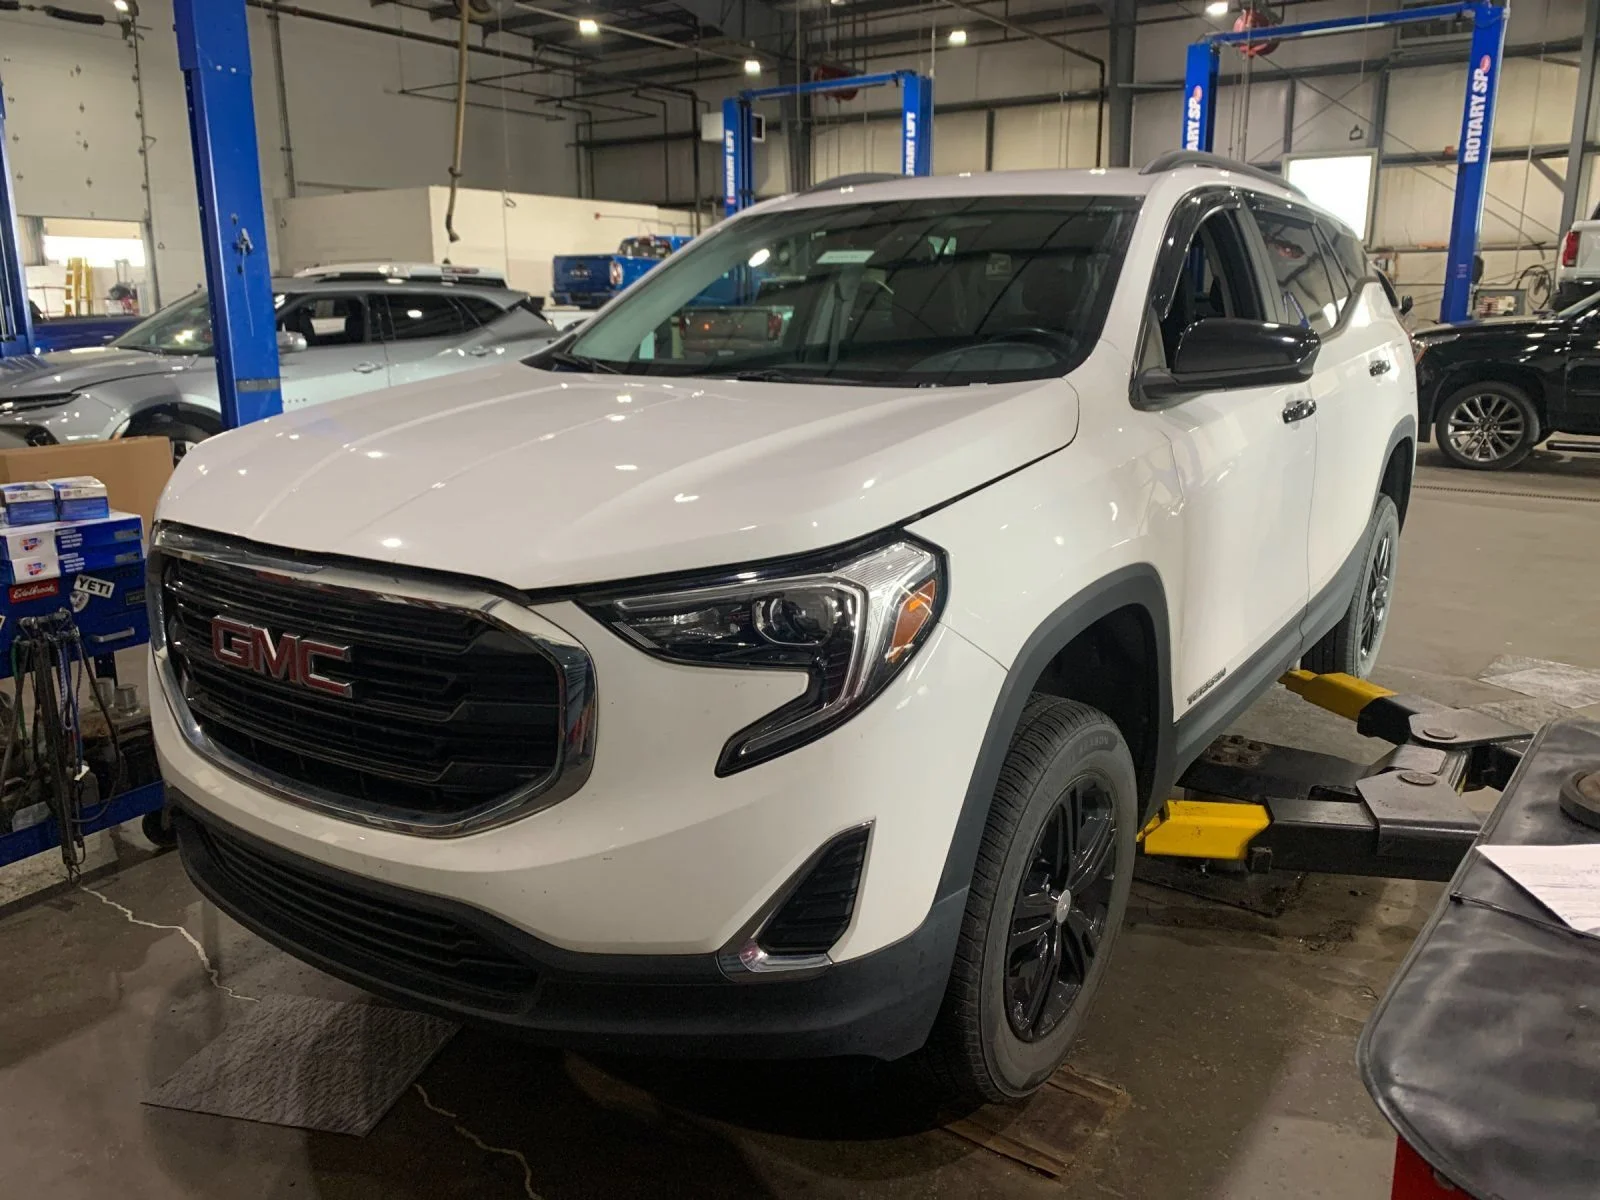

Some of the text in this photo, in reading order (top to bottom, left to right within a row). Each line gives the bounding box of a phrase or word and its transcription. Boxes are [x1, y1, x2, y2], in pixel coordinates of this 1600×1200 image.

[1472, 68, 1489, 93] SP
[1188, 96, 1201, 119] SP
[906, 111, 916, 137] LIFT
[1464, 94, 1486, 163] ROTARY
[725, 130, 734, 153] LIFT
[79, 577, 111, 595] YETI
[211, 614, 353, 698] GMC
